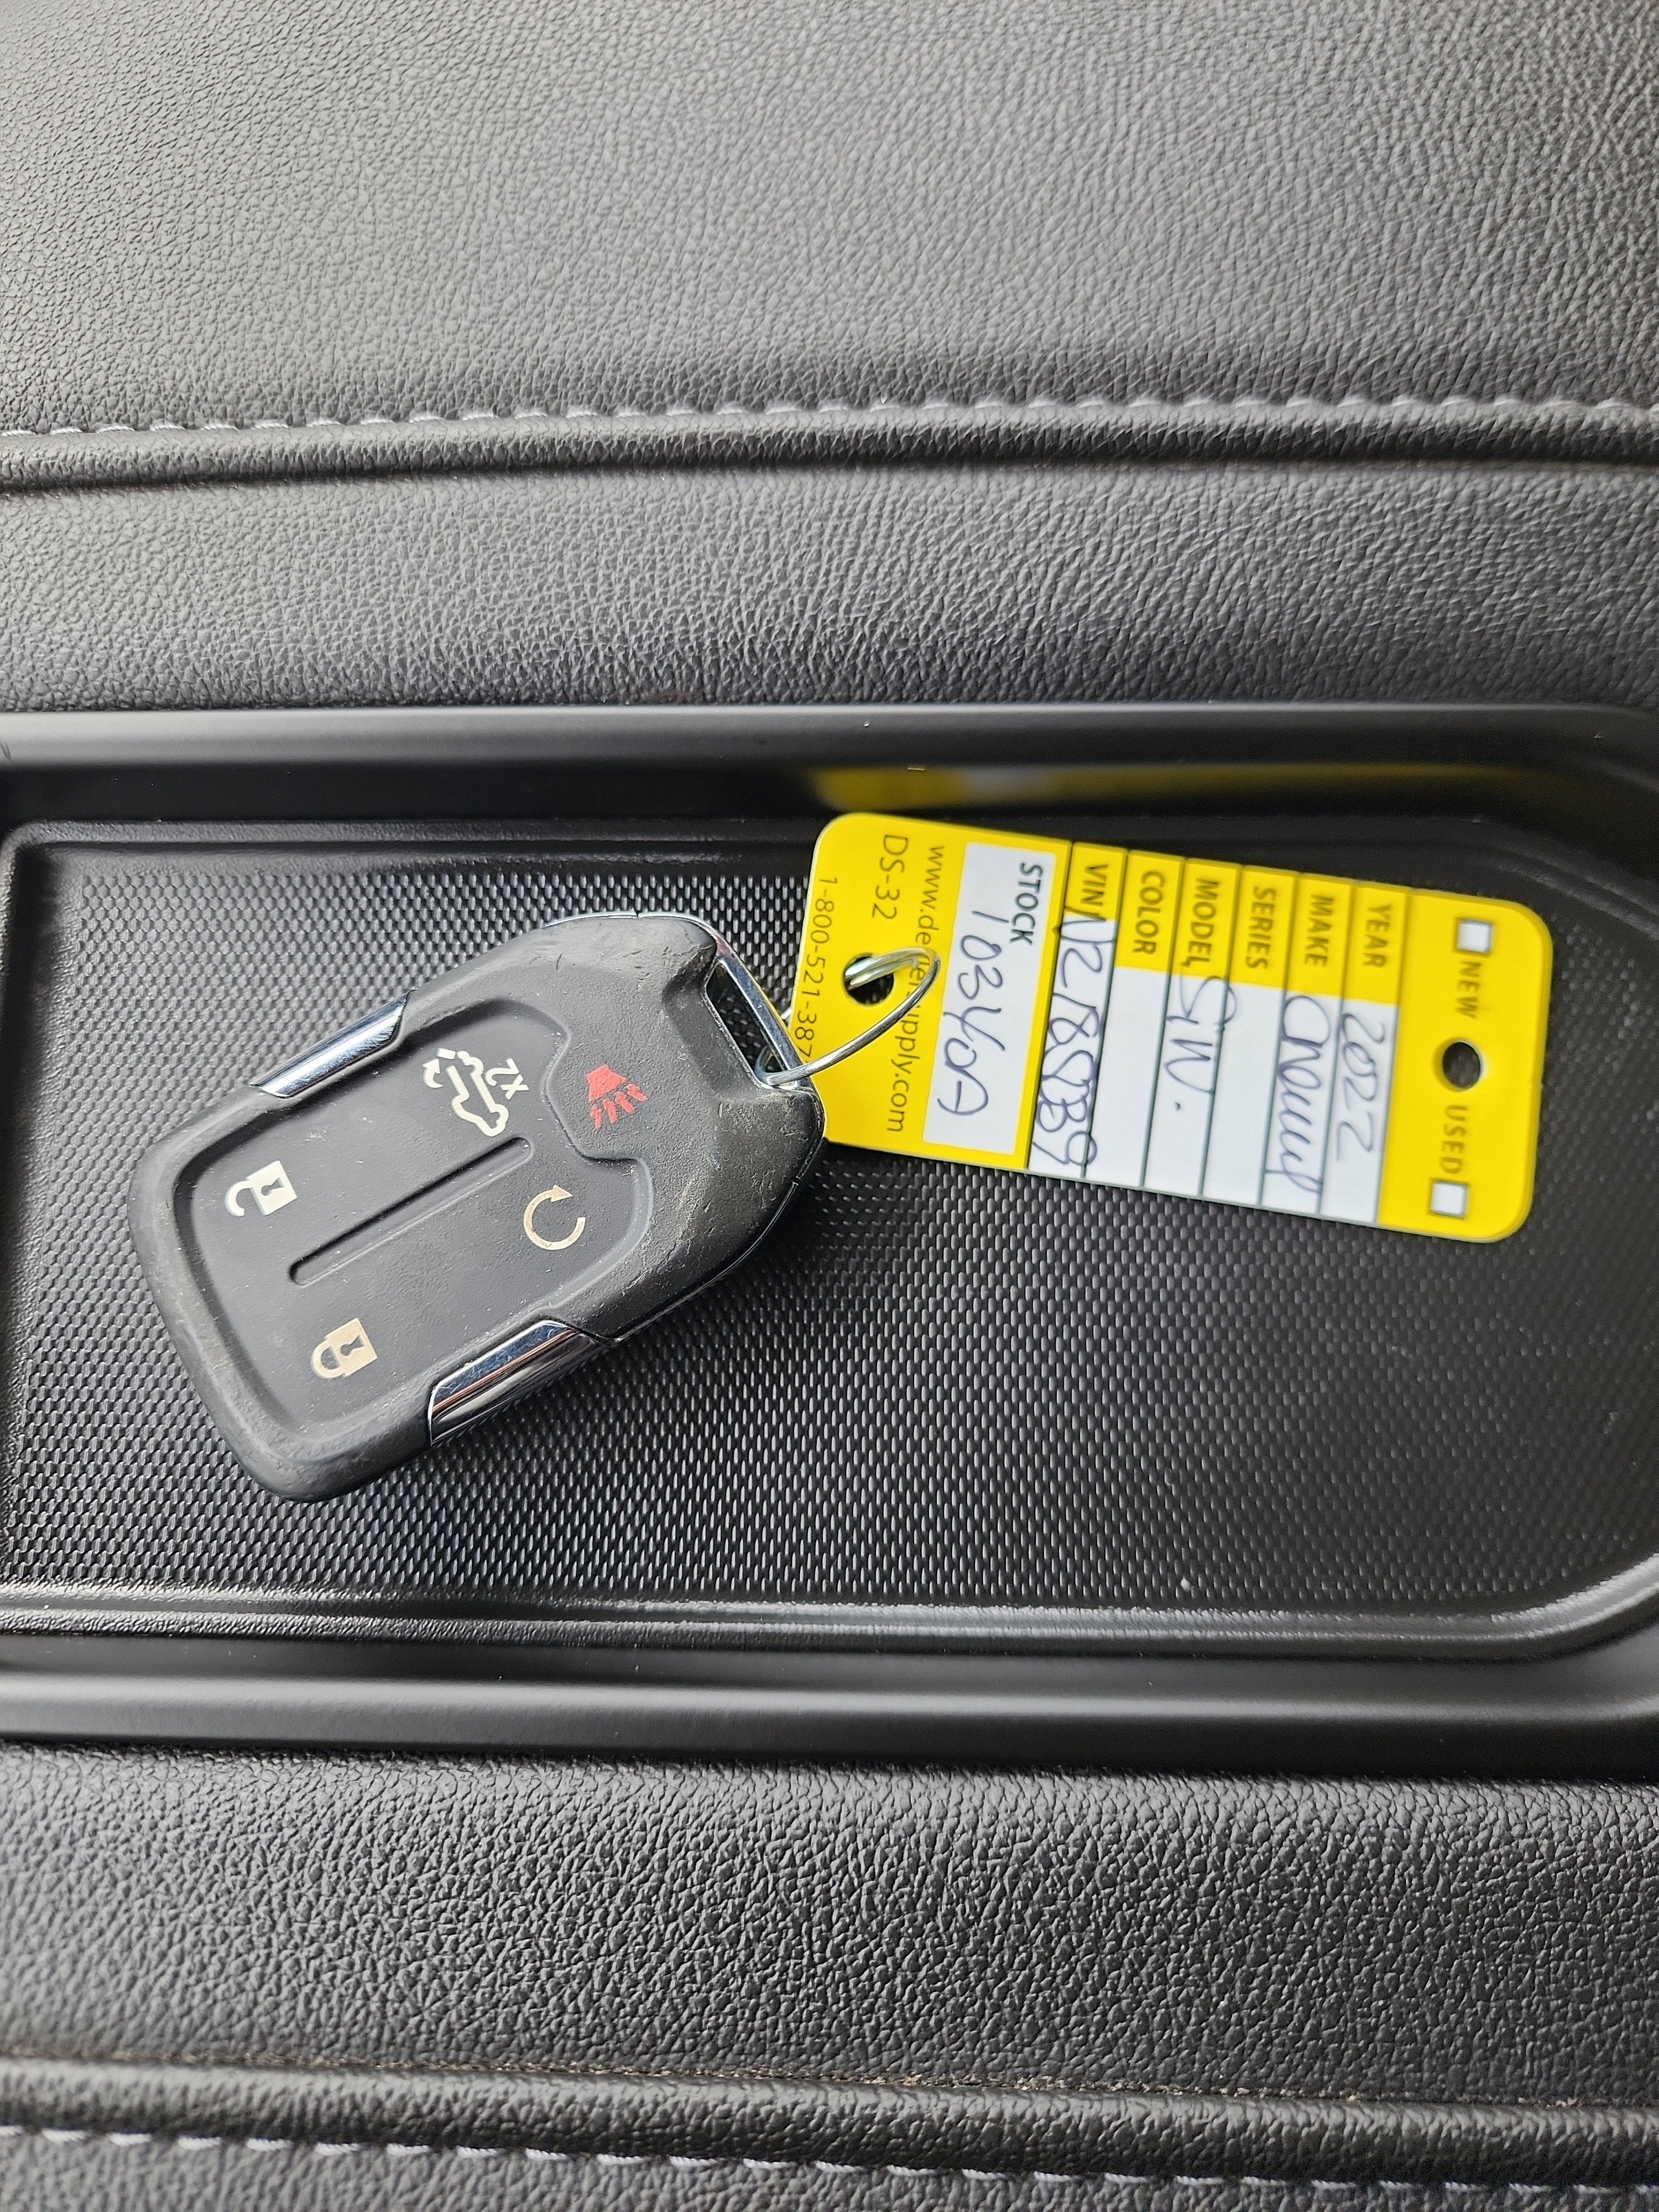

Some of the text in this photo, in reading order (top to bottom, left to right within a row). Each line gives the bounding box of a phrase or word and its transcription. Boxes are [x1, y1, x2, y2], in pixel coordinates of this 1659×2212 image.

[872, 834, 909, 920] DS-32
[1009, 862, 1044, 946] STOCK
[1079, 863, 1108, 907] VIN
[1131, 870, 1165, 956] COLOR
[1188, 876, 1218, 964] MODEL
[1245, 885, 1277, 970] SERIES
[1304, 894, 1334, 968] MAKE
[1363, 903, 1392, 969] YEAR
[794, 877, 838, 1062] 1-800-521-387
[1456, 960, 1482, 1020] NEW
[1336, 1013, 1385, 1164] 2022
[1439, 1104, 1468, 1175] USED
